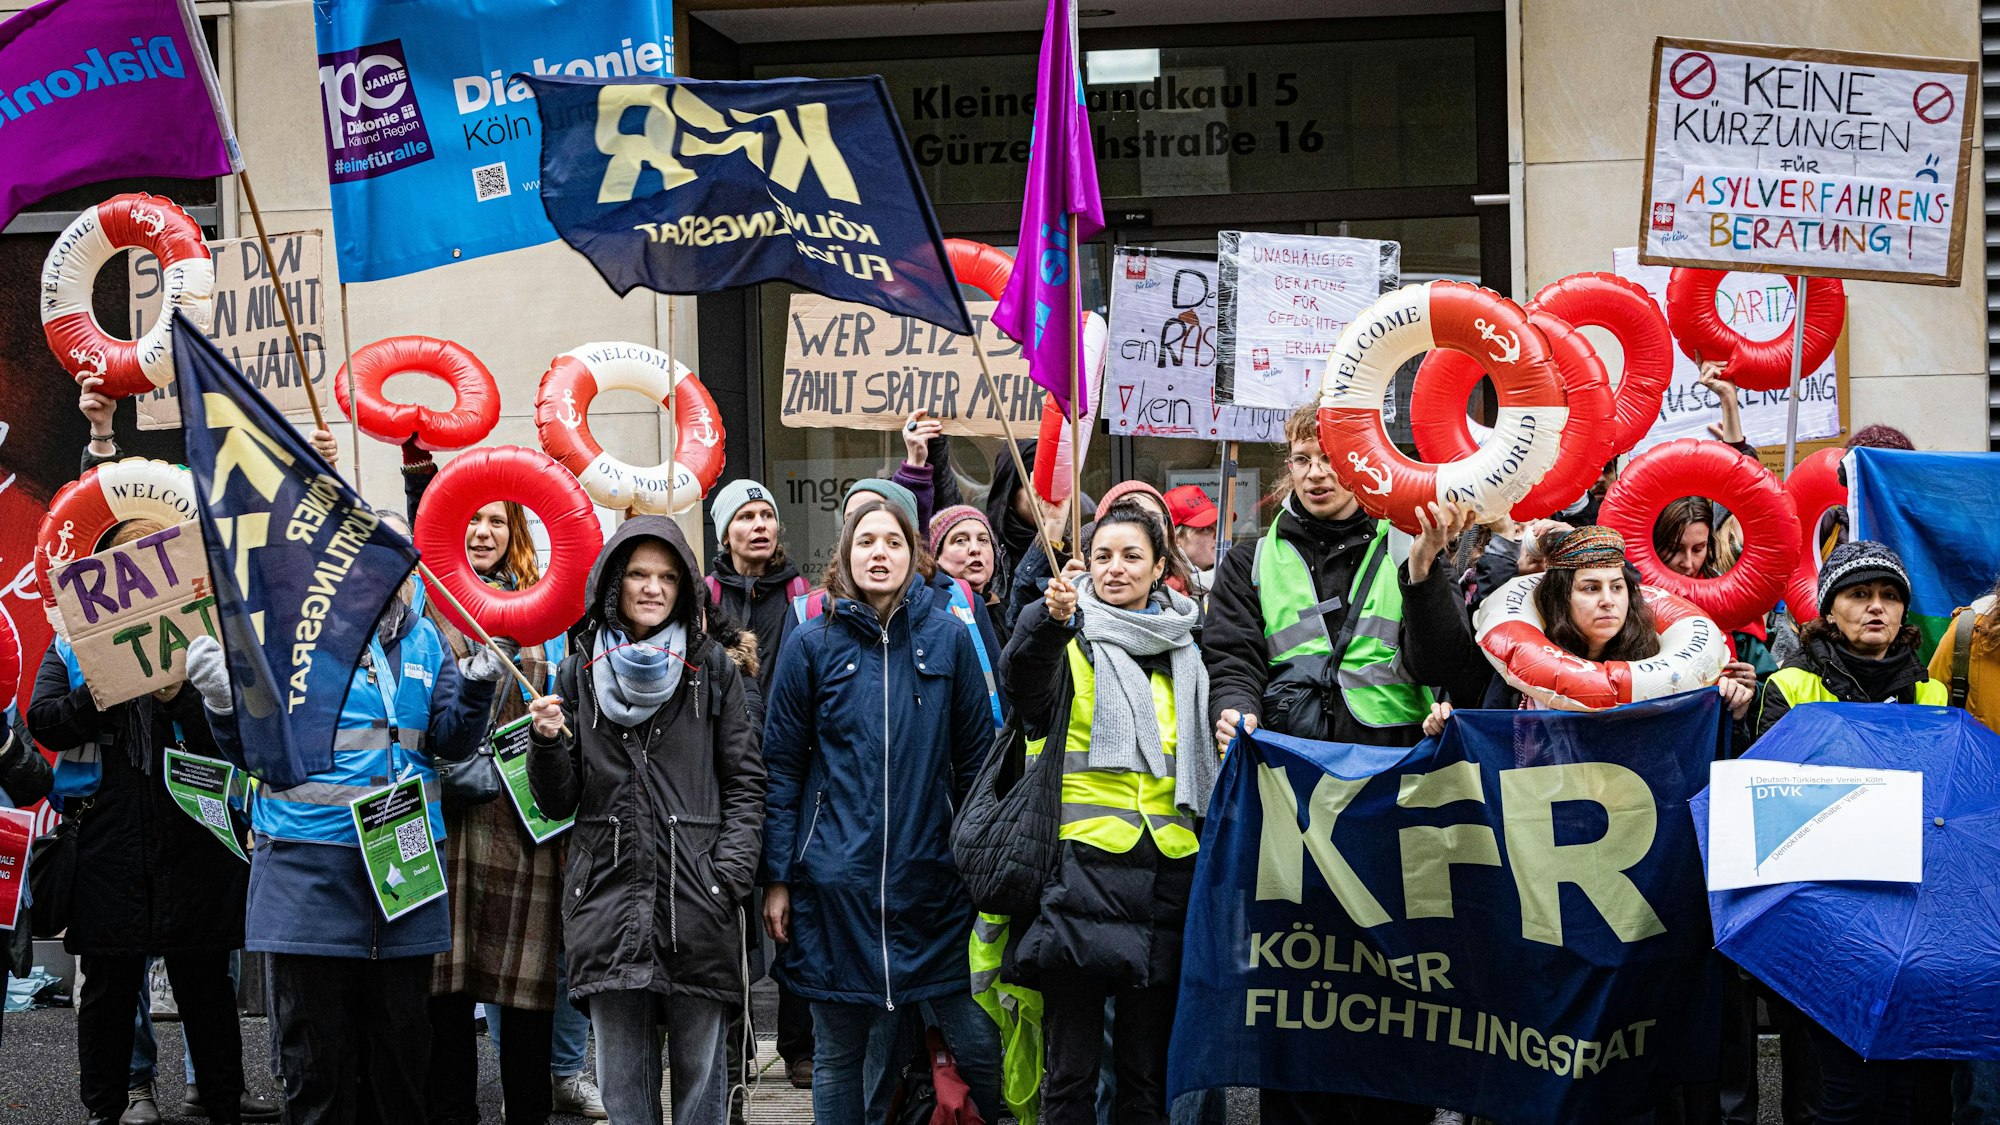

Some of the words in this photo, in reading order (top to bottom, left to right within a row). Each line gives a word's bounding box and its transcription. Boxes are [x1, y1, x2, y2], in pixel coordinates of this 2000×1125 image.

[365, 70, 406, 91] JAHRE
[453, 37, 664, 115] Diakonie
[1088, 73, 1257, 113] andkaul
[1275, 72, 1299, 107] 5
[1744, 62, 1876, 116] KEINE
[362, 131, 381, 145] und
[382, 121, 420, 139] Region
[463, 114, 532, 150] Köln
[1275, 119, 1324, 154] 16
[1673, 100, 1911, 152] KÜRZUNGEN
[334, 142, 427, 174] #einefüralle
[1780, 155, 1821, 174] FÜR
[1686, 175, 1950, 223] ASYLVERFAHRENS-
[1253, 246, 1354, 267] UNABHÄNGIGE
[1709, 213, 1892, 255] BERATUNG
[46, 217, 95, 313] WELCOME
[1274, 275, 1346, 292] BERATUNG
[245, 277, 320, 333] NICHT
[1268, 310, 1348, 331] GEFLÜCHTET
[1292, 295, 1320, 312] FÜR
[144, 341, 165, 366] ON
[791, 311, 876, 358] WER
[1334, 305, 1422, 399] WELCOME
[232, 332, 326, 390] WAND
[782, 368, 857, 416] ZAHLT
[861, 365, 960, 420] SPÄTER
[965, 372, 1049, 422] MEHR
[1136, 380, 1193, 425] kein
[598, 461, 624, 481] ON
[1444, 484, 1477, 504] ON
[1485, 415, 1537, 490] WORLD
[112, 483, 199, 520] WELCO
[57, 525, 182, 624] RAT
[1507, 574, 1545, 616] WELCO
[112, 595, 220, 678] TAT
[1638, 658, 1670, 674] ON
[1674, 618, 1710, 662] WORLD
[1756, 776, 1834, 784] Deutsch-Türkischer
[1836, 776, 1862, 784] Verein
[1756, 785, 1803, 799] DTVK
[1771, 826, 1811, 861] Demokratie
[1813, 803, 1842, 825] Teilhabe
[1846, 787, 1869, 803] Vielfalt
[1255, 760, 1668, 947] KFR
[1249, 922, 1455, 993] KÖLNER
[1245, 980, 1657, 1080] FLÜCHTLINGSRAT
